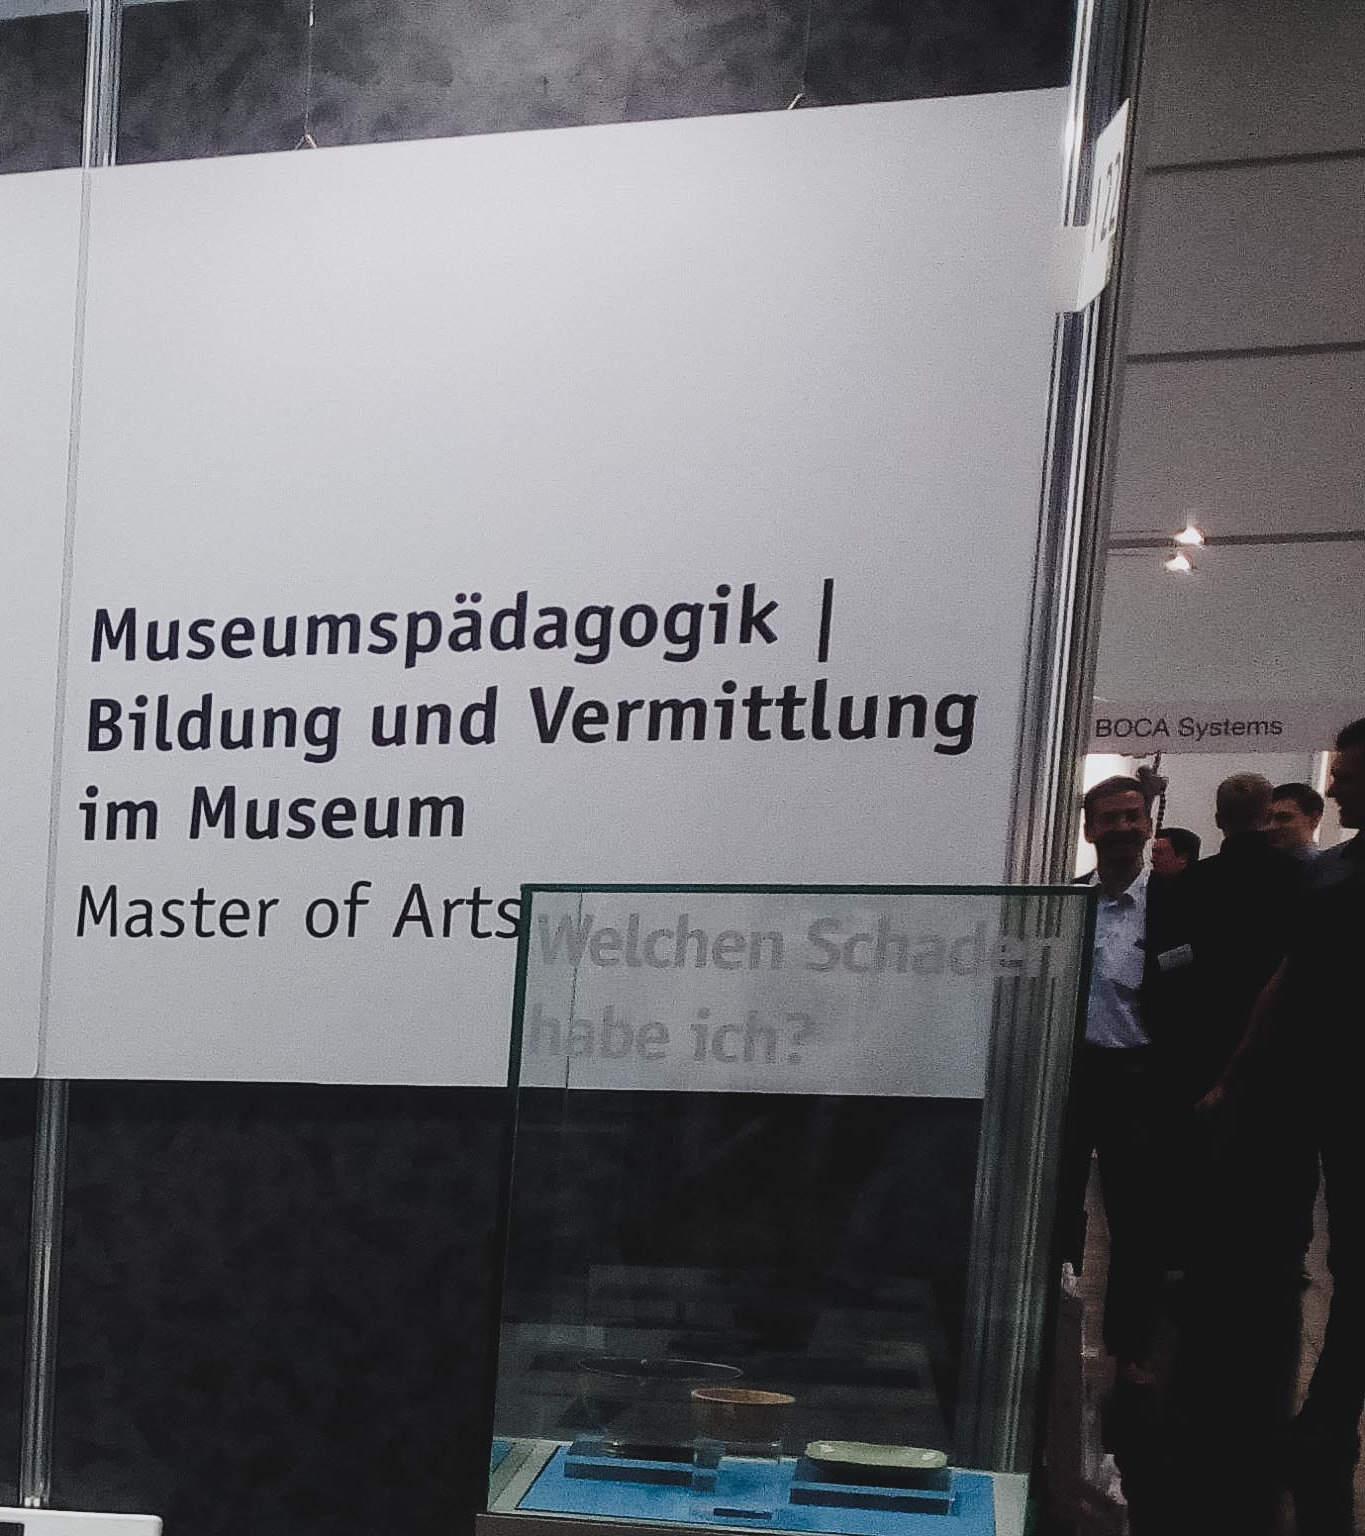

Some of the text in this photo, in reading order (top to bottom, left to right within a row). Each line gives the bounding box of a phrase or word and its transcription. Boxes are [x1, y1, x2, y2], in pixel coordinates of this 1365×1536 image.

[91, 583, 779, 669] Museumspädagogik
[86, 679, 979, 763] Bildung und Vermittlung
[1096, 717, 1283, 741] BOCA Systems
[79, 785, 466, 840] im Museum
[76, 880, 520, 939] Master of Arts
[537, 912, 784, 971] Welchen
[524, 1003, 812, 1066] habe ich?
